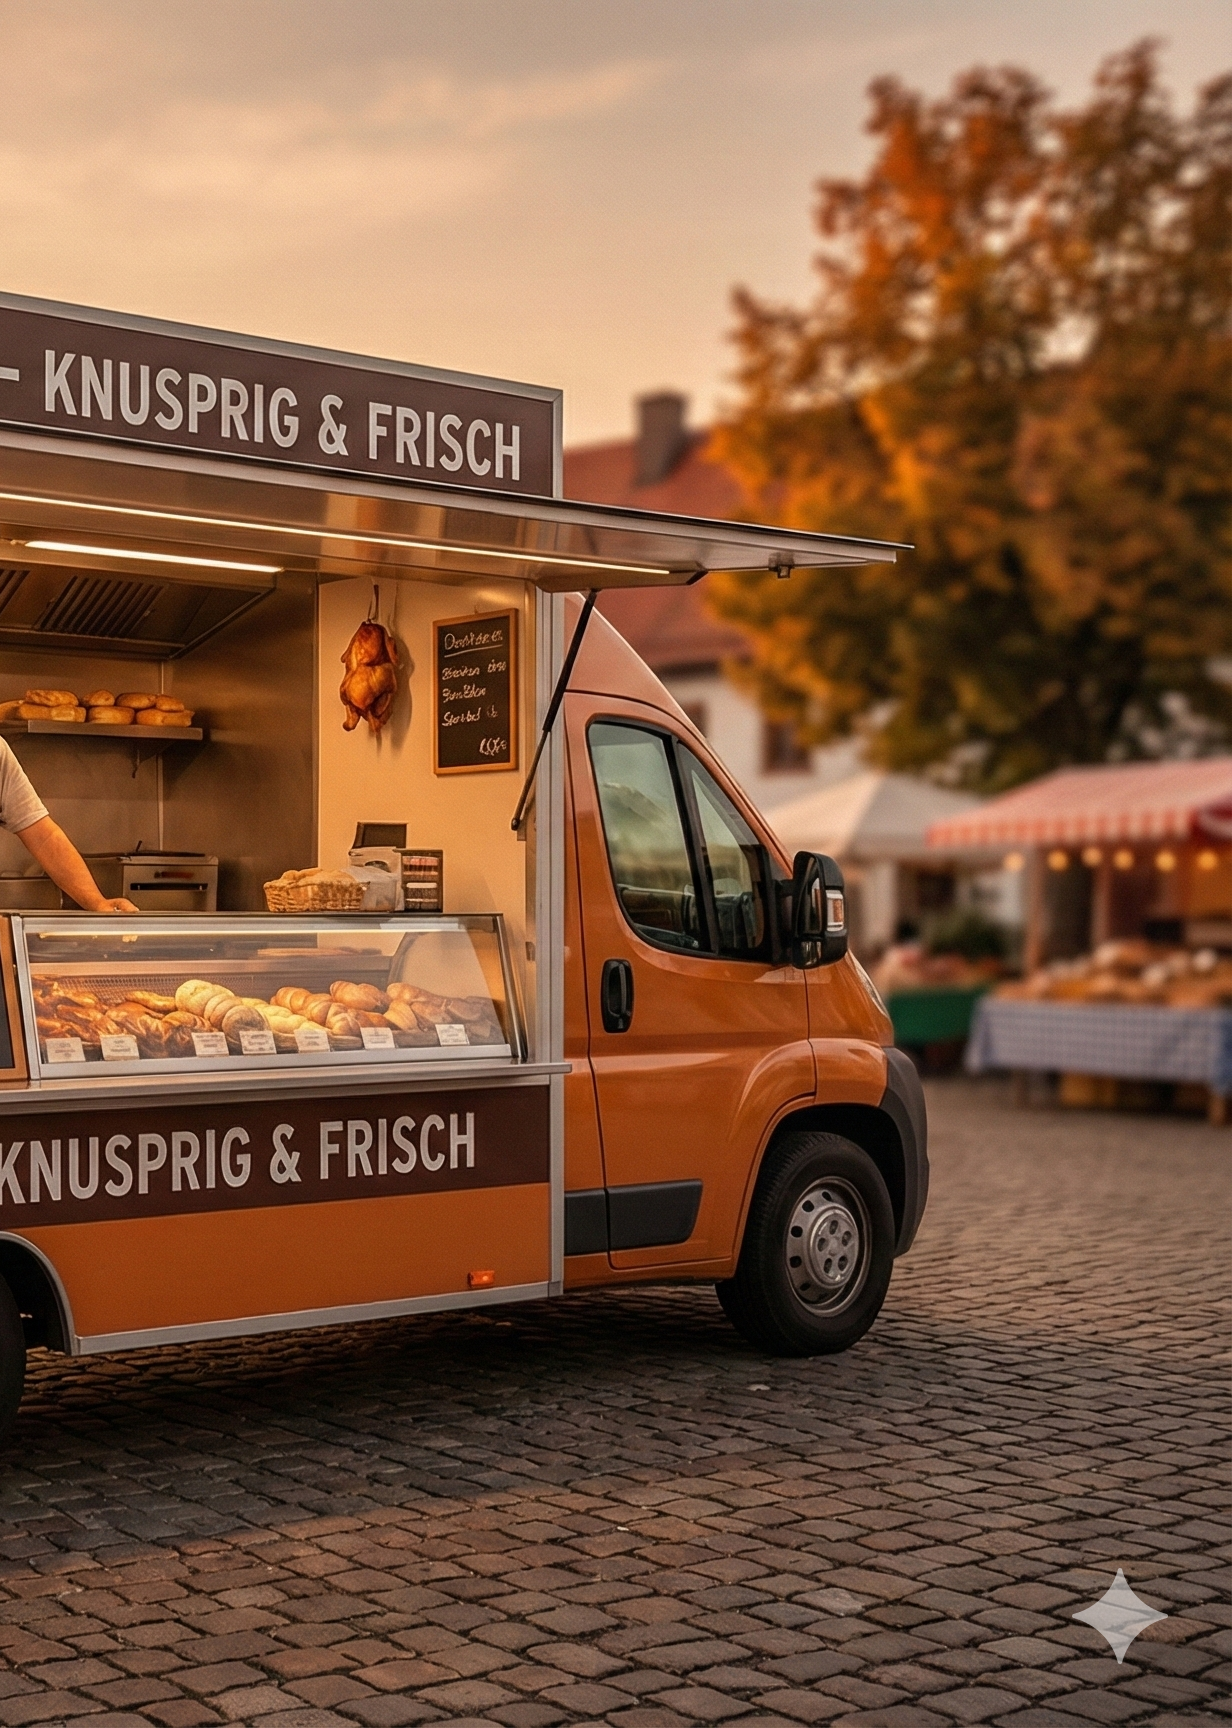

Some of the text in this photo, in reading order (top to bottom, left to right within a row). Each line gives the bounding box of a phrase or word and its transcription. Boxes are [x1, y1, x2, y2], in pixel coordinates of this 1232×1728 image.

[44, 349, 300, 449] KNUSPRIG
[317, 394, 349, 456] &
[368, 400, 521, 481] FRISCH
[269, 1123, 302, 1184] &
[319, 1112, 475, 1180] FRISCH
